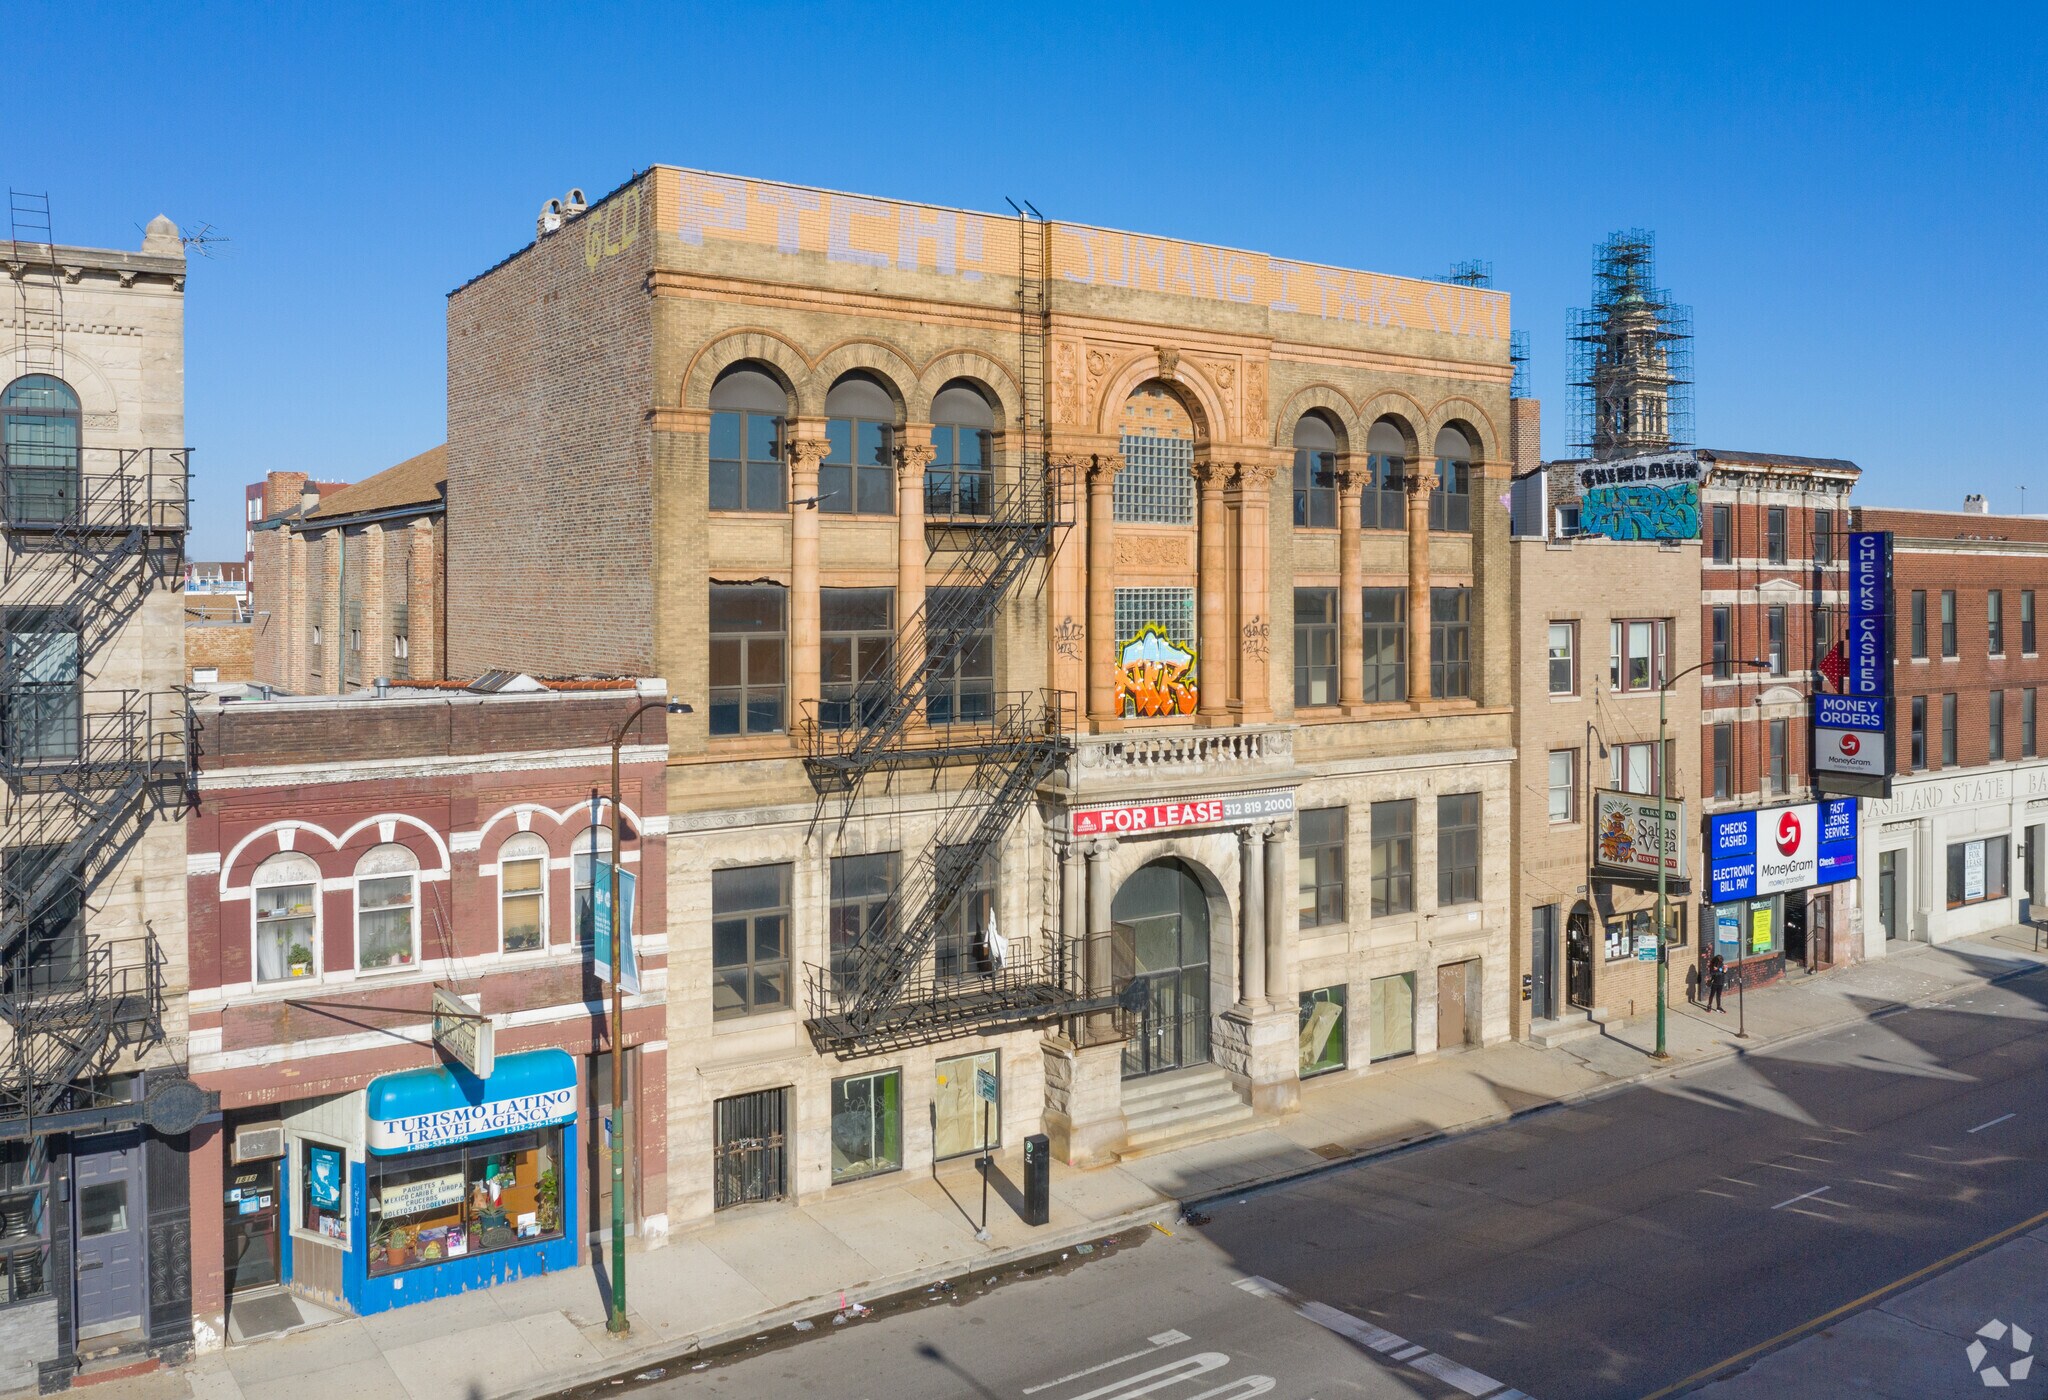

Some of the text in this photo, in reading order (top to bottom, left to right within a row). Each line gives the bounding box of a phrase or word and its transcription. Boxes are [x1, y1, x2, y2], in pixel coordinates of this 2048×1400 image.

[1859, 536, 1876, 611] CHECKS
[1859, 618, 1876, 692] CASHED
[1823, 699, 1878, 714] MONEY
[1820, 712, 1880, 726] ORDERS
[1868, 785, 1943, 817] ASHLAND
[1953, 777, 2006, 804] STATE
[1100, 809, 1147, 832] FOR
[1153, 801, 1222, 828] LEASE
[1225, 801, 1242, 816] 312
[1244, 800, 1262, 814] 819
[1264, 797, 1293, 812] 2000
[1640, 808, 1675, 819] CARNAS
[1829, 802, 1845, 815] FAST
[1825, 813, 1850, 827] LICENSE
[1720, 821, 1748, 836] CHECKS
[1825, 825, 1850, 839] SERVICE
[1720, 834, 1748, 848] CASHED
[1638, 855, 1676, 867] RESTAANT
[1968, 850, 1980, 859] FOR
[1713, 864, 1755, 881] ELECTRONIC
[1761, 860, 1813, 877] MoneyGram
[1720, 878, 1749, 893] BILL PAY
[384, 1090, 571, 1134] TURISMO LATINO
[405, 1106, 553, 1144] TRAVEL AGENCY
[407, 1116, 563, 1151] 1-888-534-8755 1-312-226-1546
[384, 1183, 464, 1204] MEXICO CARIBE EUROPA
[402, 1181, 436, 1194] PAQUETES
[406, 1195, 438, 1206] CRUCEROS
[483, 1229, 512, 1245] OPEN
